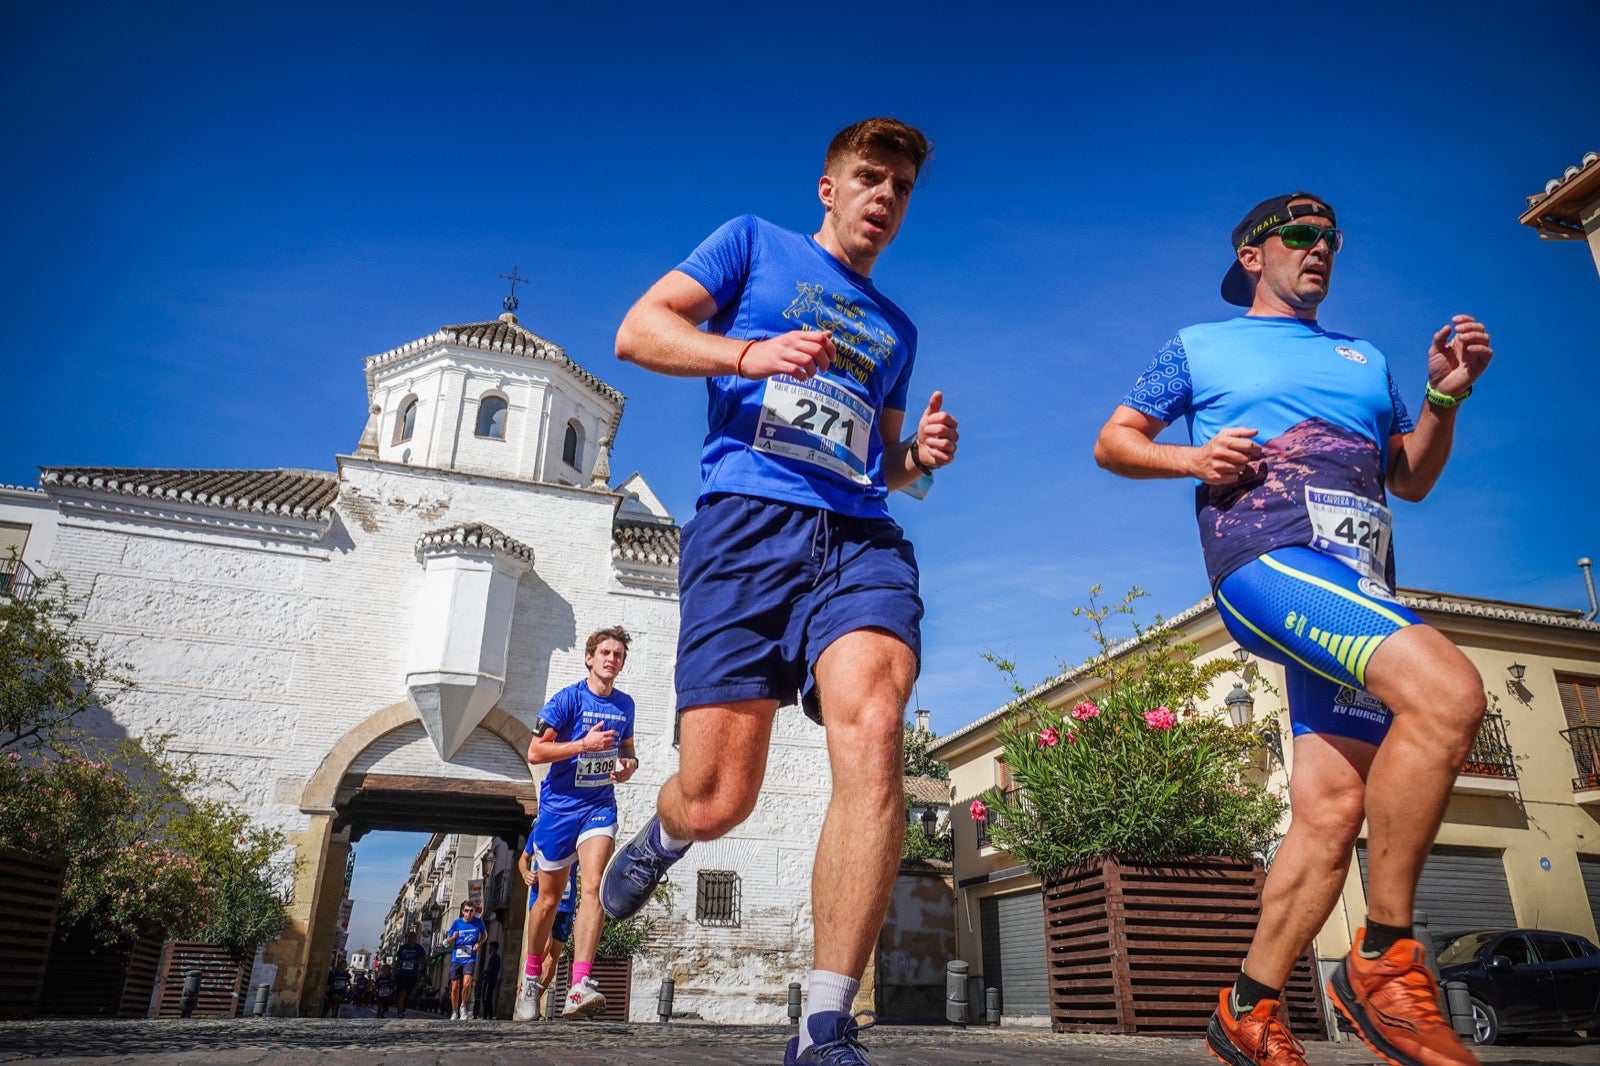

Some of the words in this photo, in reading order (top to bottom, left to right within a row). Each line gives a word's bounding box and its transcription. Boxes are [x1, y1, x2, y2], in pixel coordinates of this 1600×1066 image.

[1252, 215, 1280, 236] TRAIL
[791, 398, 854, 449] 271
[1322, 494, 1350, 507] CARRERA
[1334, 516, 1380, 556] 421
[1333, 704, 1349, 716] KV
[1348, 706, 1386, 725] DURCAL
[585, 760, 614, 774] 1309
